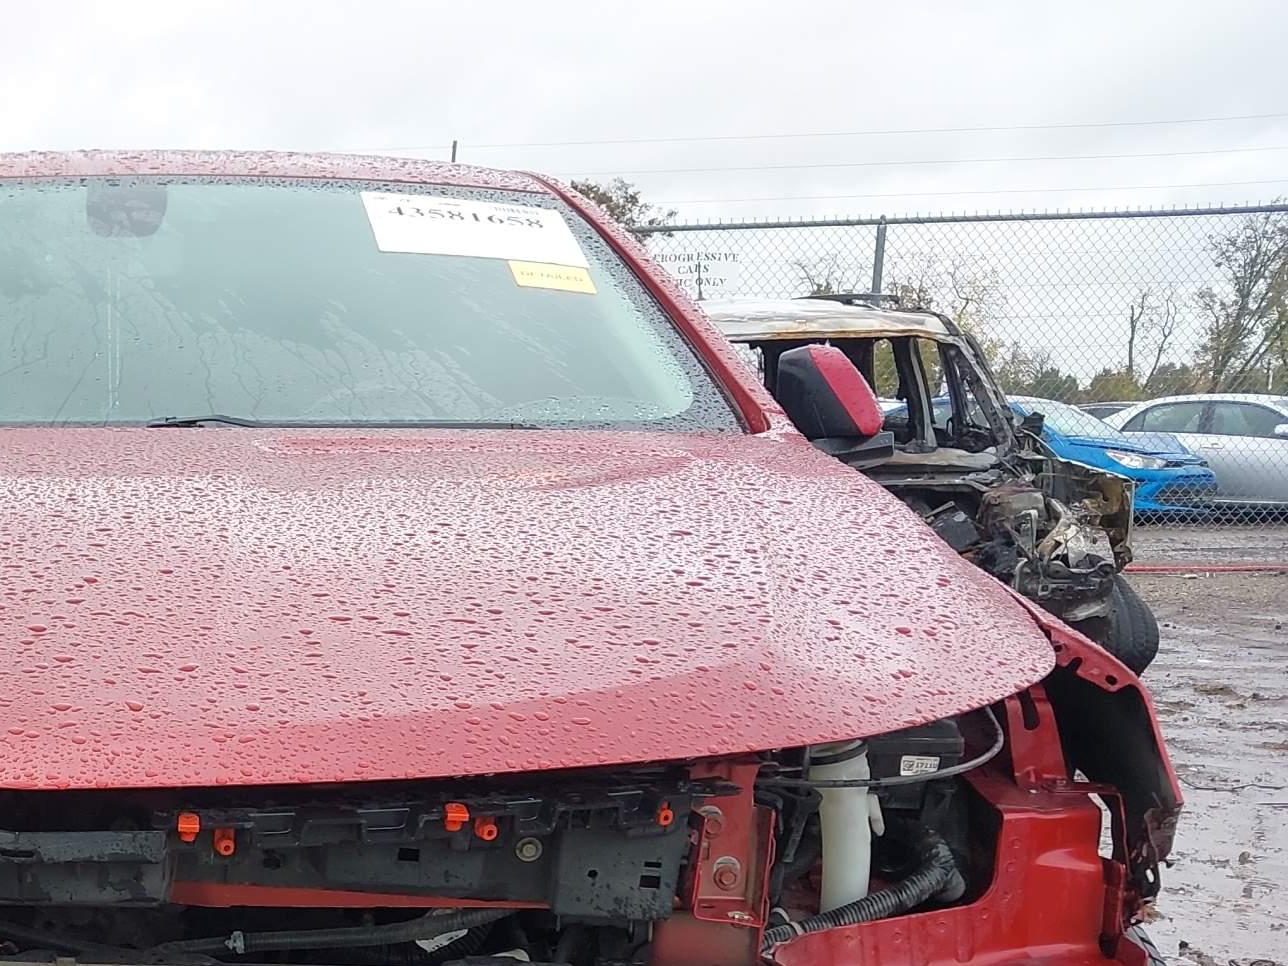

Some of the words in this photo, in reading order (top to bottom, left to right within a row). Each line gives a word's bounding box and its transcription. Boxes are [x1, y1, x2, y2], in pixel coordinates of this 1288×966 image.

[388, 205, 544, 229] 43581658
[653, 252, 740, 262] PROGRESSIVE
[695, 277, 727, 287] ONLY
